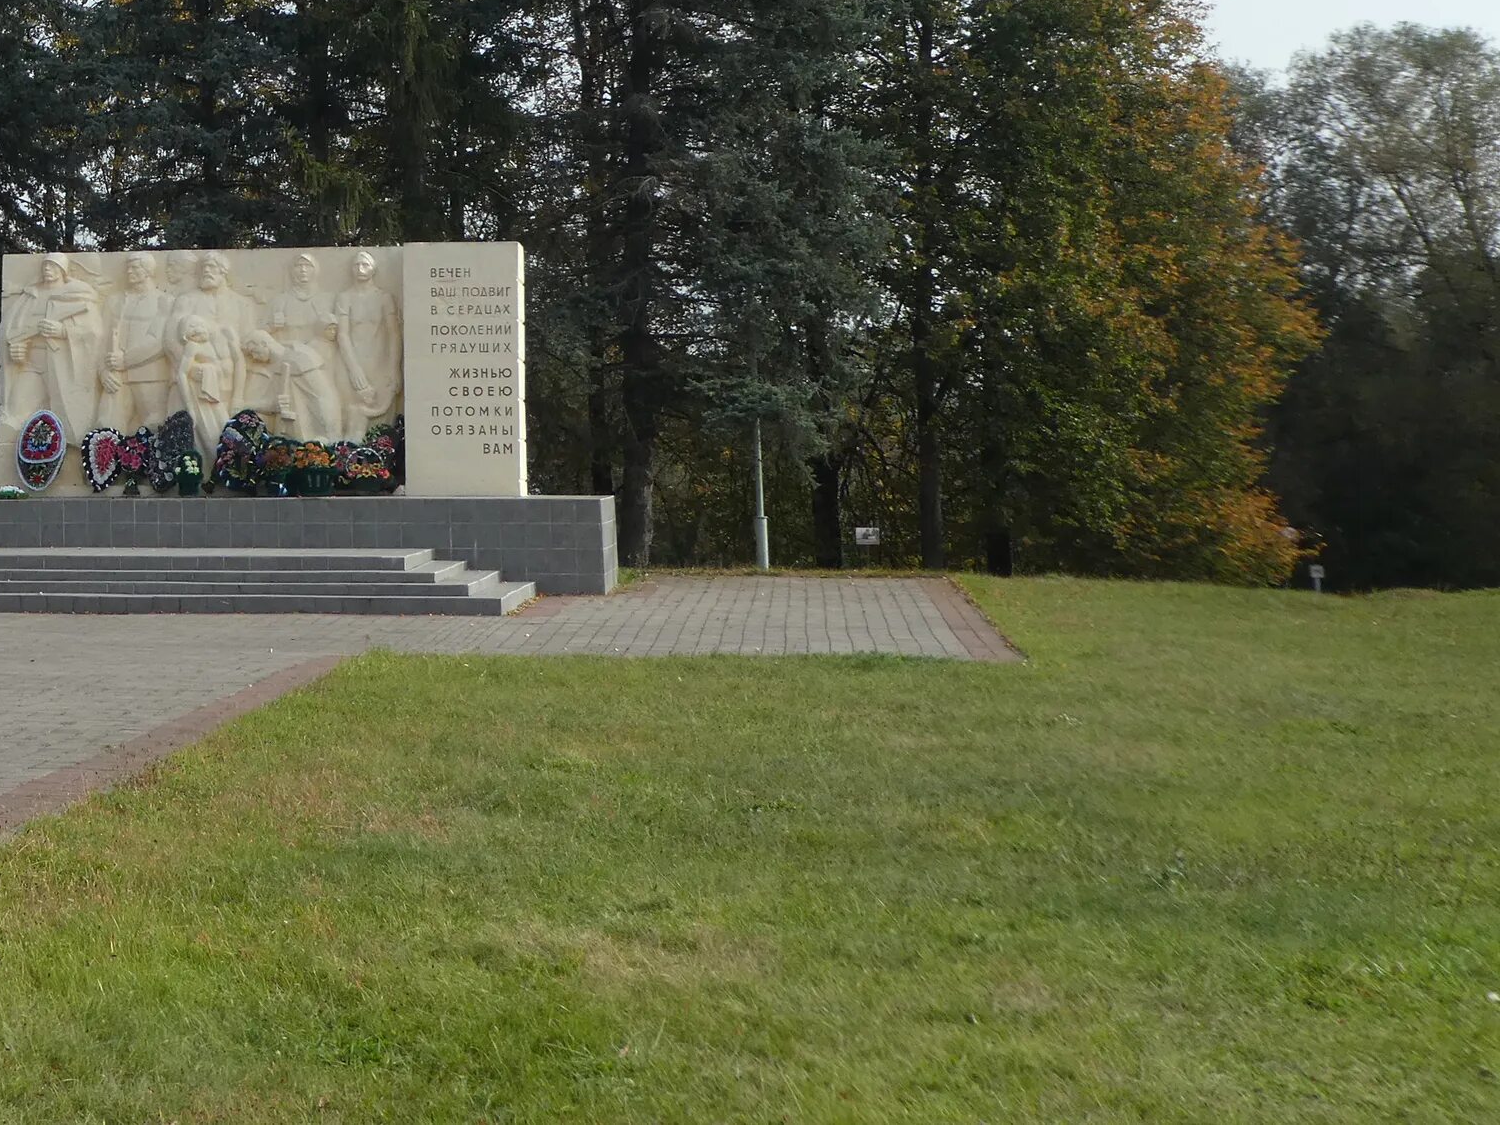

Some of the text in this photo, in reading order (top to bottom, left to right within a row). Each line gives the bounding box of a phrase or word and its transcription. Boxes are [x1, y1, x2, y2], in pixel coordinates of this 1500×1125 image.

[430, 268, 471, 278] ВЕЧЕН
[431, 287, 511, 297] ВАШ ПОДВИГ
[431, 305, 511, 315] В СЕРДЦАХ
[431, 322, 512, 335] ПОКОЛЕНИЙ
[449, 368, 512, 378] ЖИЗНЬЮ
[449, 386, 513, 397] СВОЕЮ
[431, 406, 513, 417] ПОТОМКИ
[431, 425, 513, 435] ОБЯЗАНЫ
[483, 444, 513, 454] ВАМ
